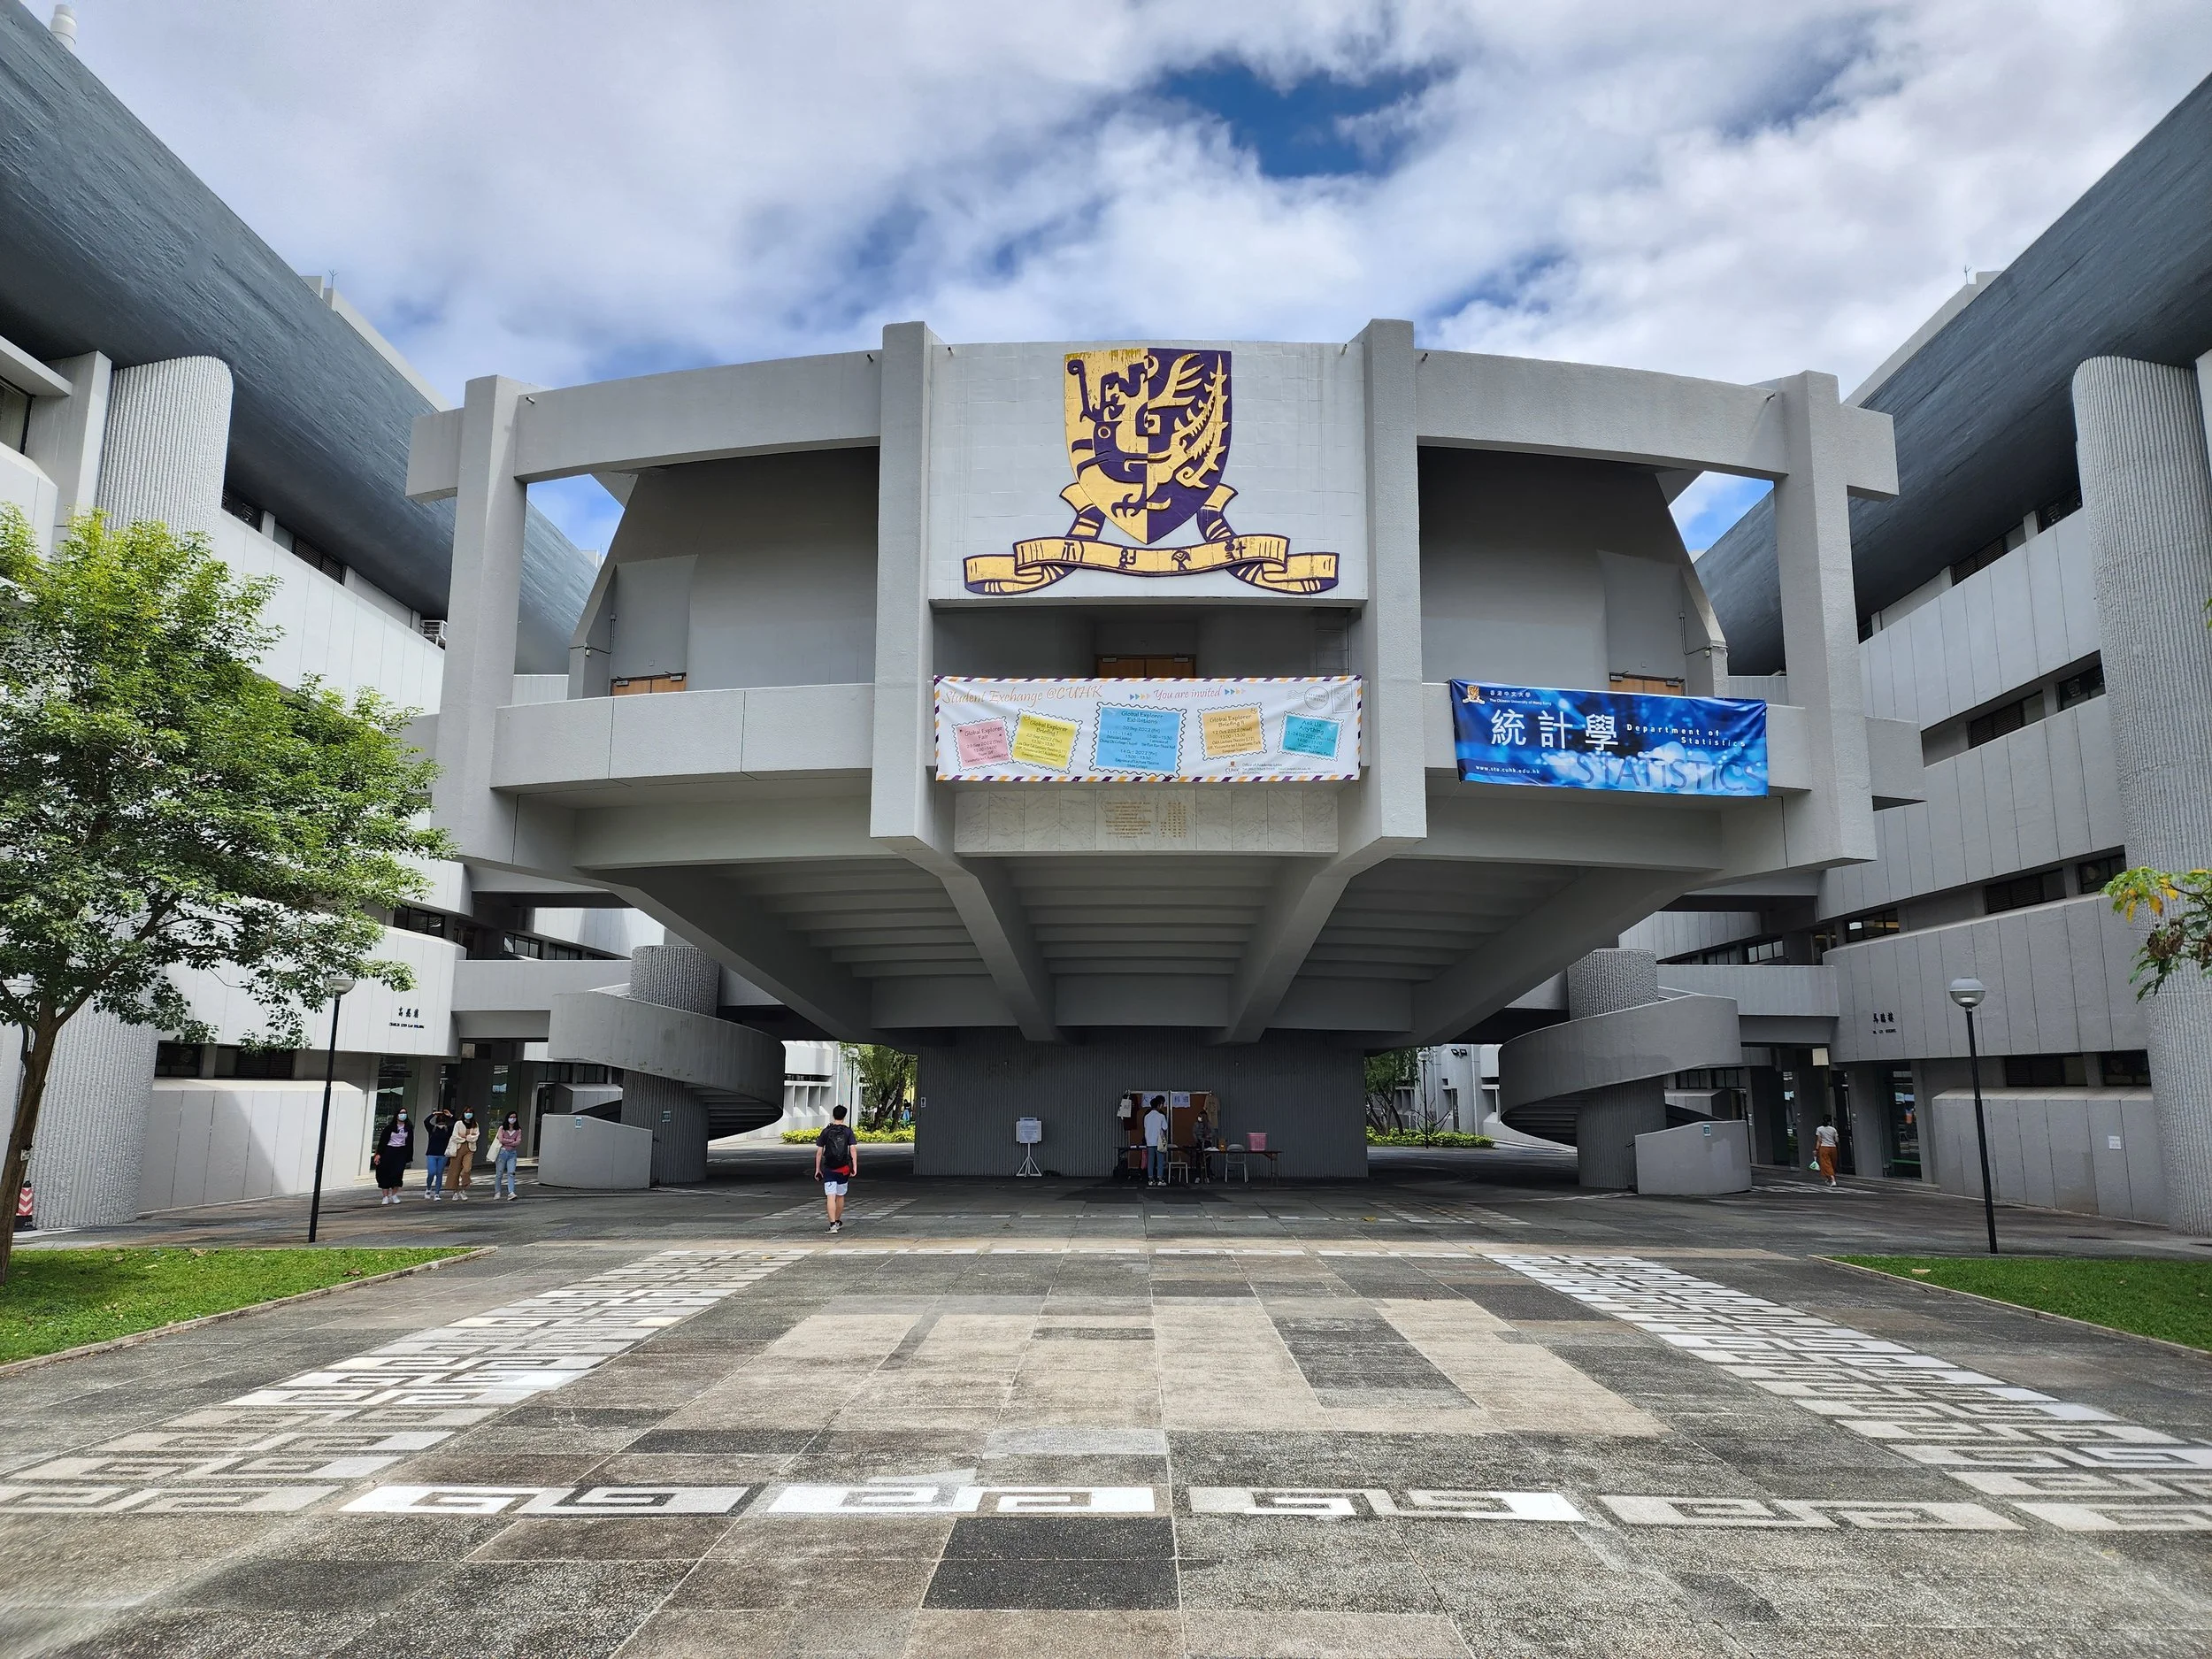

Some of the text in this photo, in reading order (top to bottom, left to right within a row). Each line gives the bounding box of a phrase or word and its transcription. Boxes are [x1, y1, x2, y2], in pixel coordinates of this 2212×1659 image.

[942, 685, 1102, 707] Student Exchange @CUHK
[1153, 689, 1172, 700] You
[1191, 685, 1223, 698] invited
[1228, 713, 1252, 721] Explorer
[981, 726, 1003, 734] Explorer
[1036, 727, 1056, 736] Briefing
[1046, 724, 1068, 733] Explorer
[1299, 726, 1324, 735] Anything
[1491, 708, 1619, 751] 統計學
[1627, 723, 1700, 736] Department
[1681, 737, 1746, 747] Statistics
